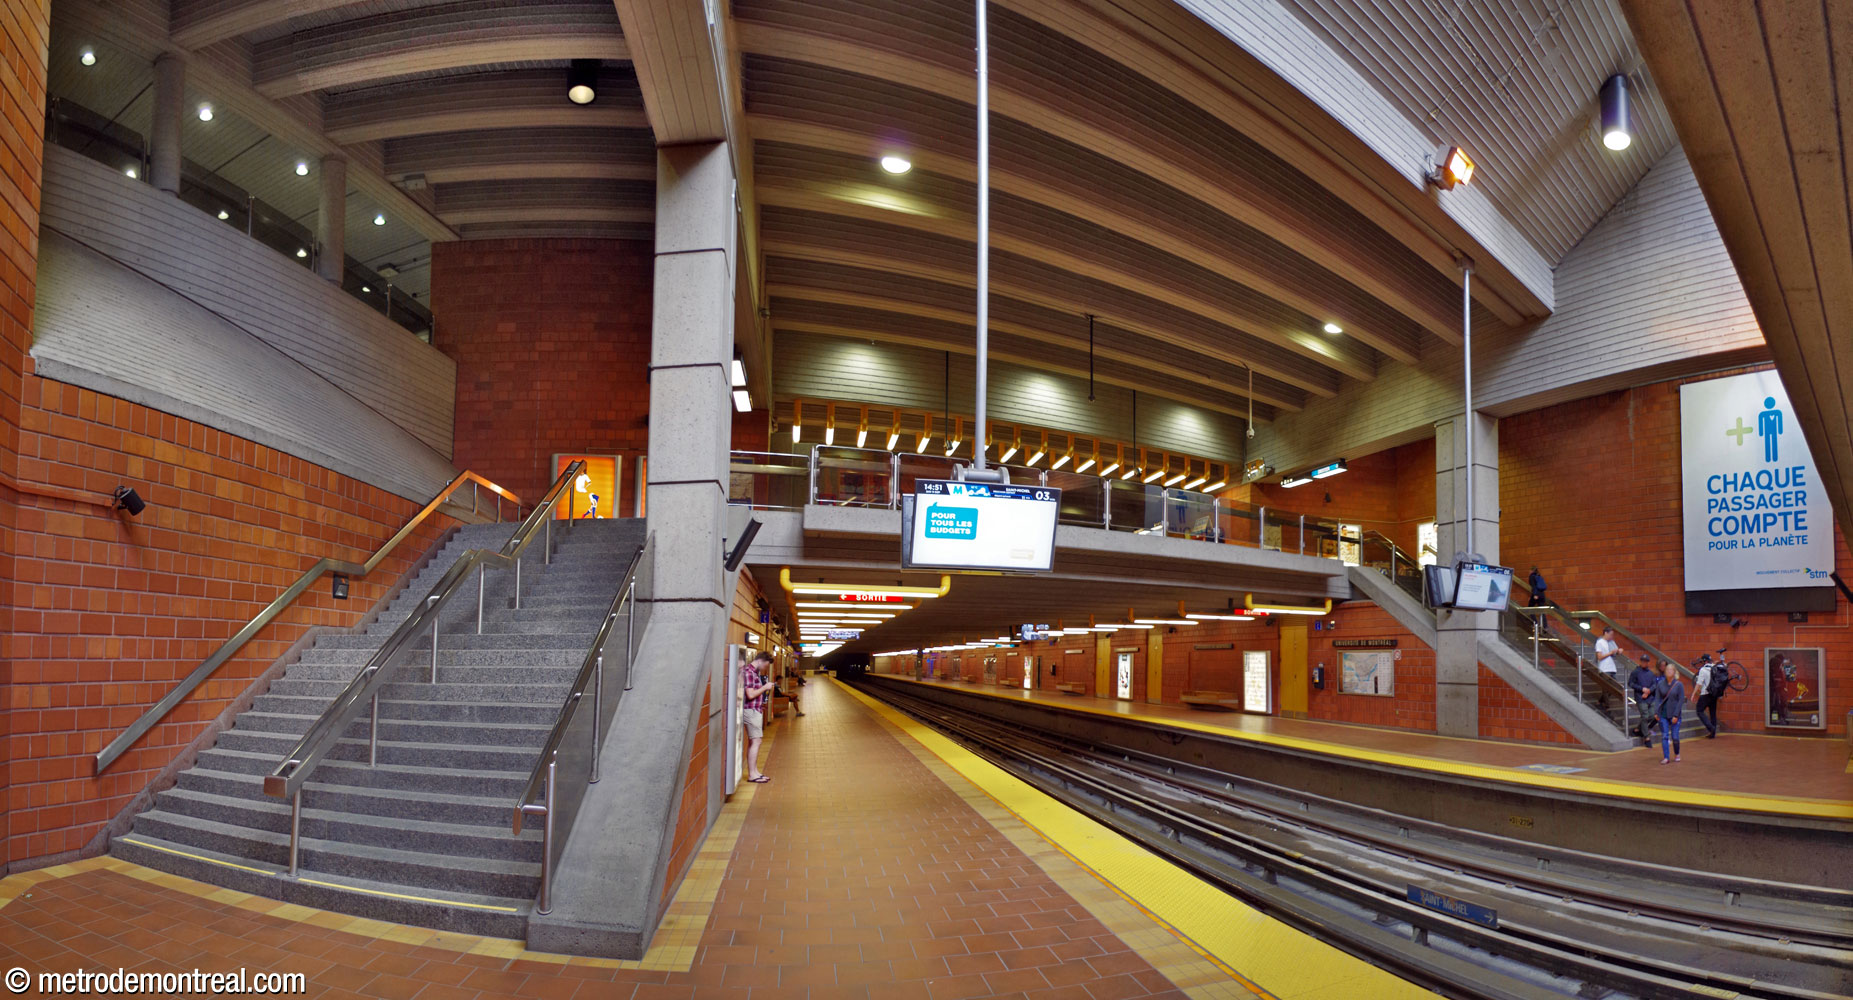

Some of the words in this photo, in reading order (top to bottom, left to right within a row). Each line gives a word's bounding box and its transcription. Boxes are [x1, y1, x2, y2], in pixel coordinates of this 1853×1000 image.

[1707, 466, 1806, 495] CHAQUE
[924, 483, 943, 491] 14:51
[1035, 490, 1050, 501] 03
[1707, 490, 1807, 514] PASSAGER
[931, 512, 956, 520] POUR
[931, 519, 954, 527] TOUS
[956, 520, 972, 528] LES
[1708, 510, 1808, 537] COMPTE
[930, 527, 971, 535] BUDGETS
[1708, 539, 1738, 551] POUR
[1741, 538, 1756, 549] LA
[1759, 534, 1808, 547] PLANÈTE
[1809, 569, 1828, 579] stm
[855, 593, 887, 601] SORTIE
